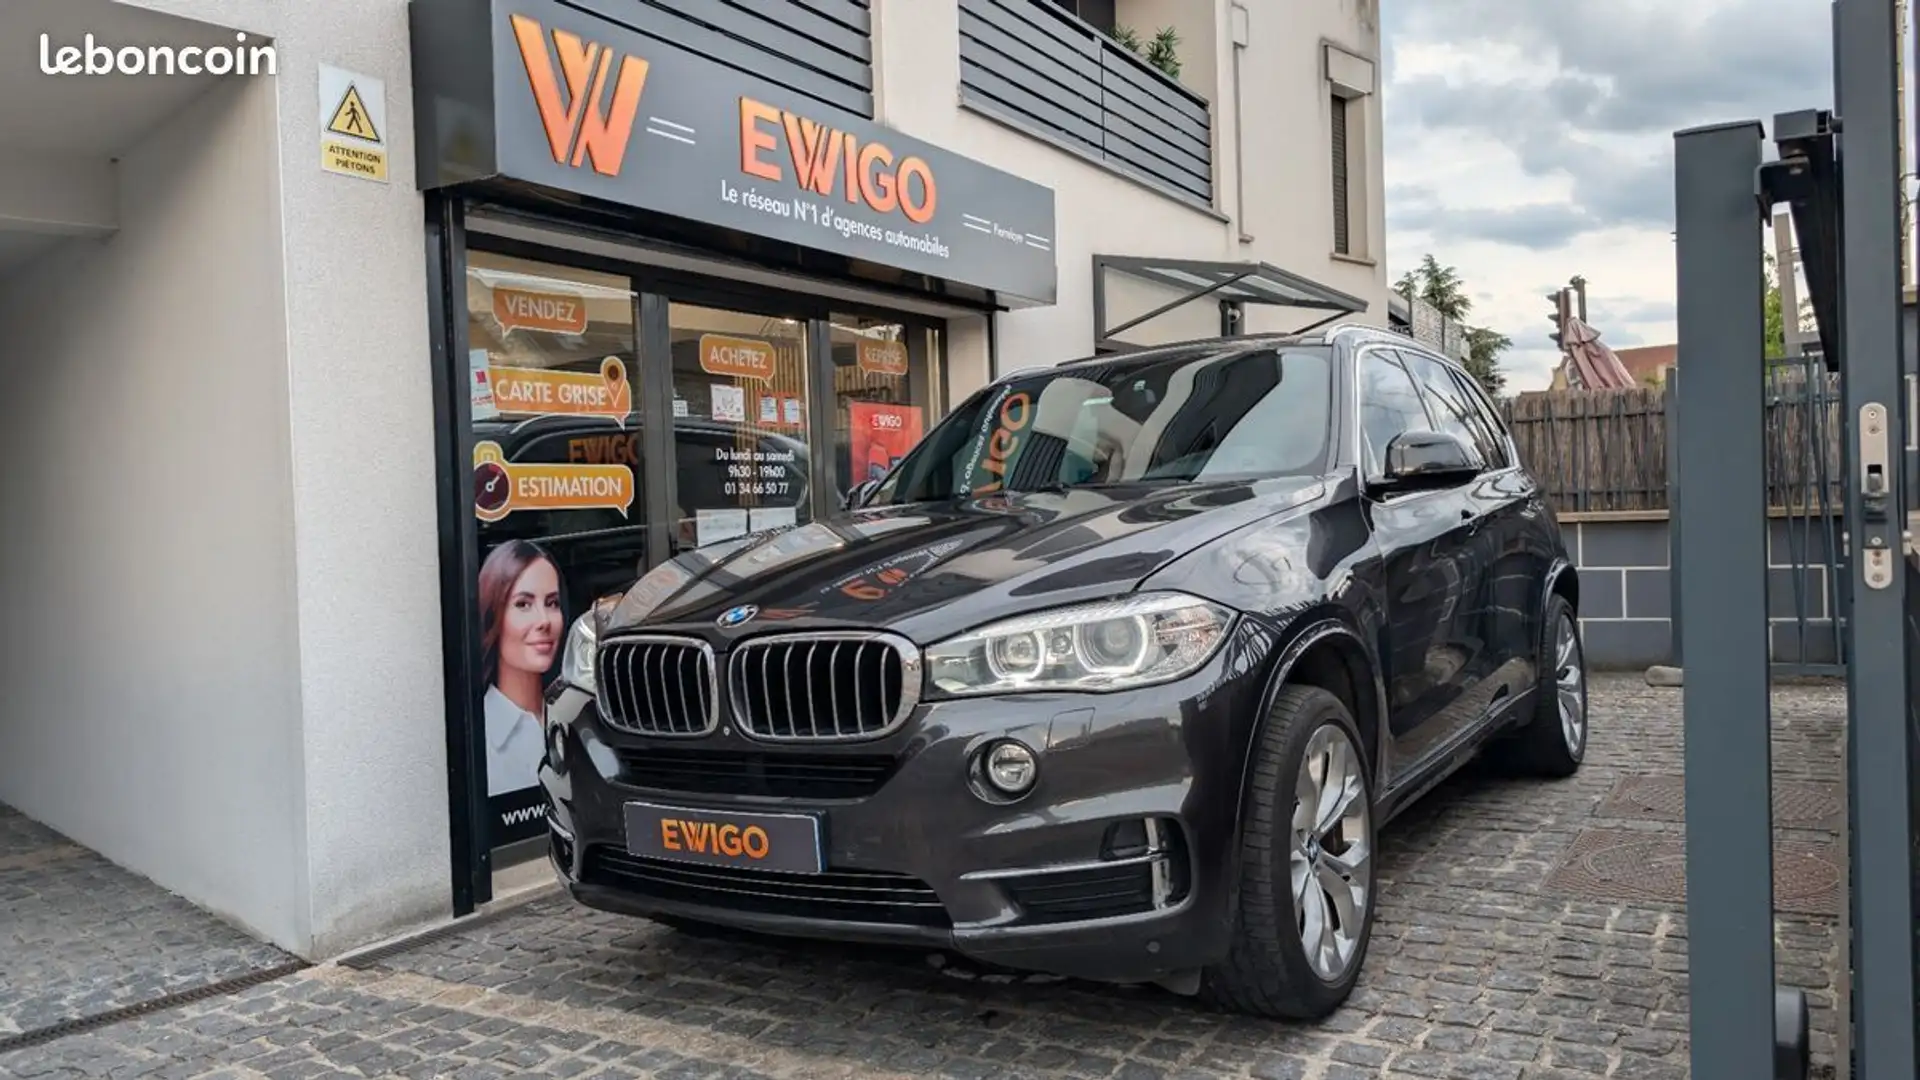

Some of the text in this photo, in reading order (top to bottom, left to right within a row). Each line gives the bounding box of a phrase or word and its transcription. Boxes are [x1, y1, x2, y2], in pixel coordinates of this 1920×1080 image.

[329, 145, 381, 163] ATTENTION
[739, 96, 937, 223] EWIGO
[721, 179, 738, 203] Le
[742, 188, 791, 217] réseau
[885, 233, 950, 258] automobiles
[504, 294, 577, 323] VENDEZ
[710, 346, 767, 369] ACHETEZ
[496, 380, 553, 404] CARTE
[558, 382, 608, 406] GRISE
[716, 447, 795, 462] Du lundi au samedi
[728, 465, 751, 478] 9h30
[760, 465, 786, 478] 19h00
[518, 476, 622, 498] ESTIMATION
[725, 482, 789, 495] 01 34 66 50 77
[661, 818, 769, 859] EWIGO
